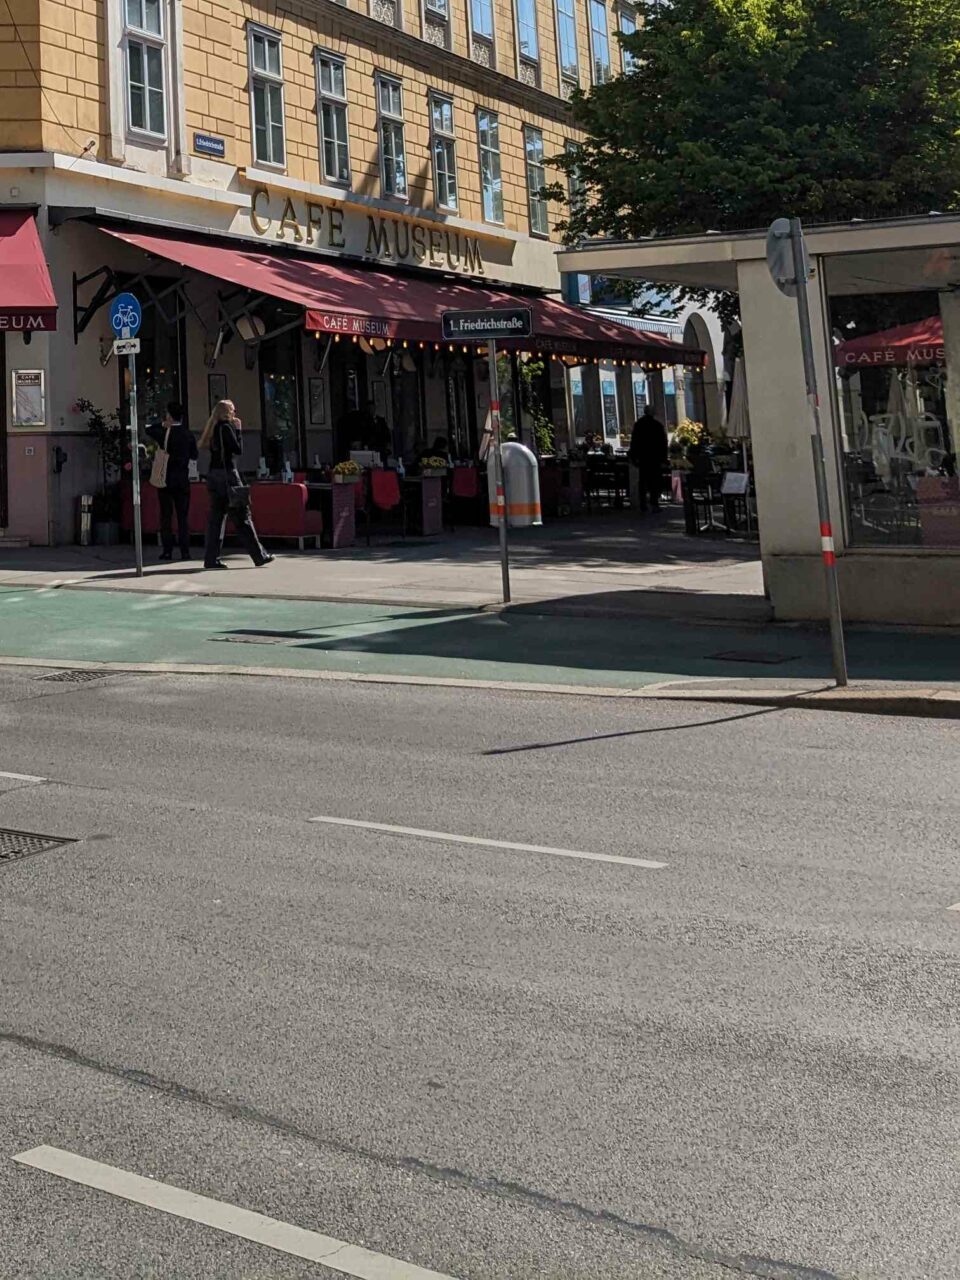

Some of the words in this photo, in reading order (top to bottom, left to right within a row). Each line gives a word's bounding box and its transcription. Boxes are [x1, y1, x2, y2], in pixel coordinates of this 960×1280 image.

[249, 187, 345, 248] CAFÉ
[365, 214, 485, 275] MUSEUM
[323, 314, 348, 330] CAFÉ
[352, 319, 390, 336] MUSEUM
[459, 316, 523, 331] Friedrichstraße
[845, 348, 896, 362] CAFÉ
